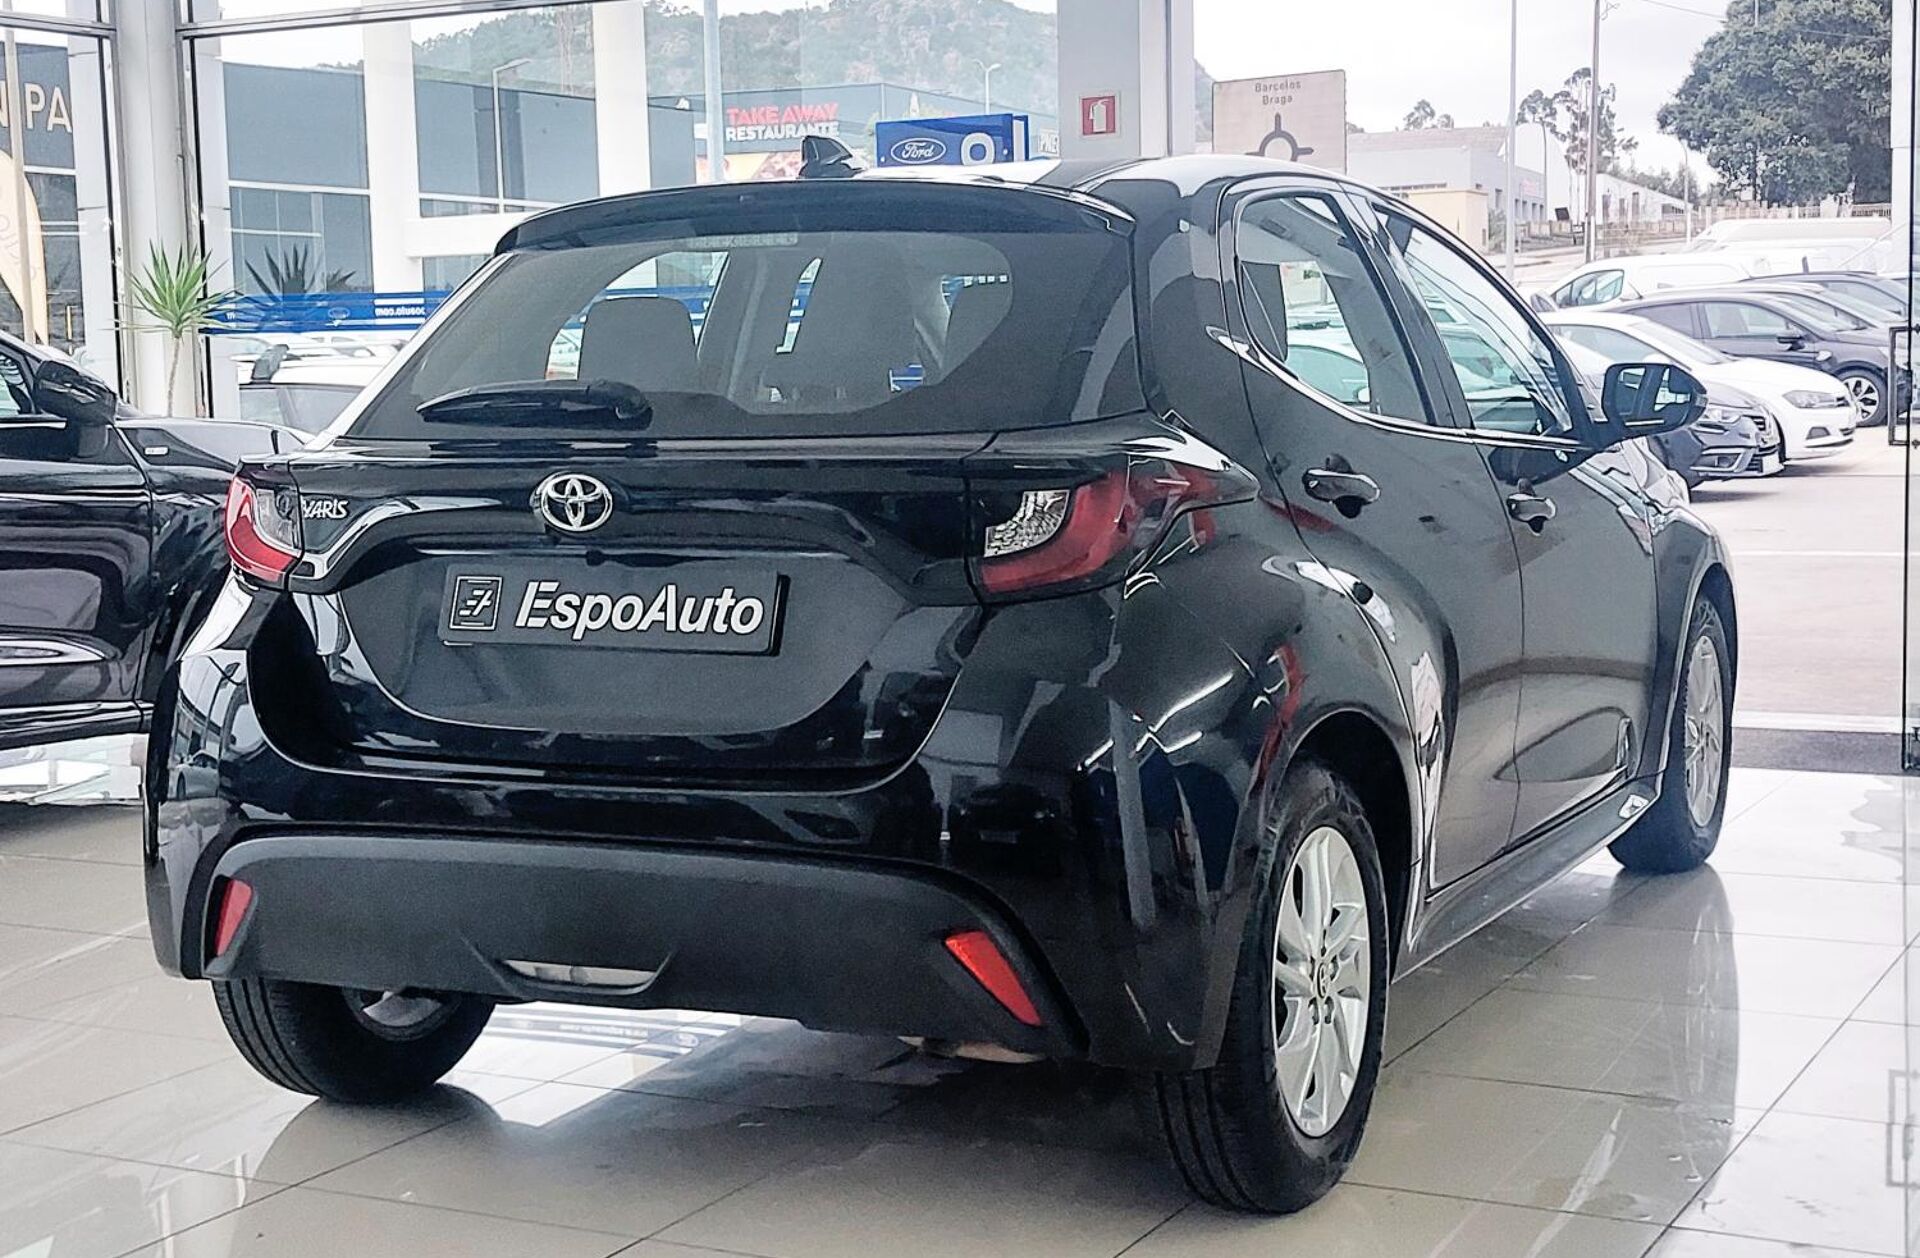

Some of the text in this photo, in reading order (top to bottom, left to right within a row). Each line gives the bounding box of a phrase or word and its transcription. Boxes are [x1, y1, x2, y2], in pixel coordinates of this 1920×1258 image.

[1255, 81, 1301, 92] Barcelos
[1262, 95, 1293, 105] Braga
[726, 101, 838, 125] TAKE AWAY
[725, 122, 839, 141] RESTAURANTE
[302, 499, 349, 519] YARIS
[515, 581, 764, 640] EspoAuto
